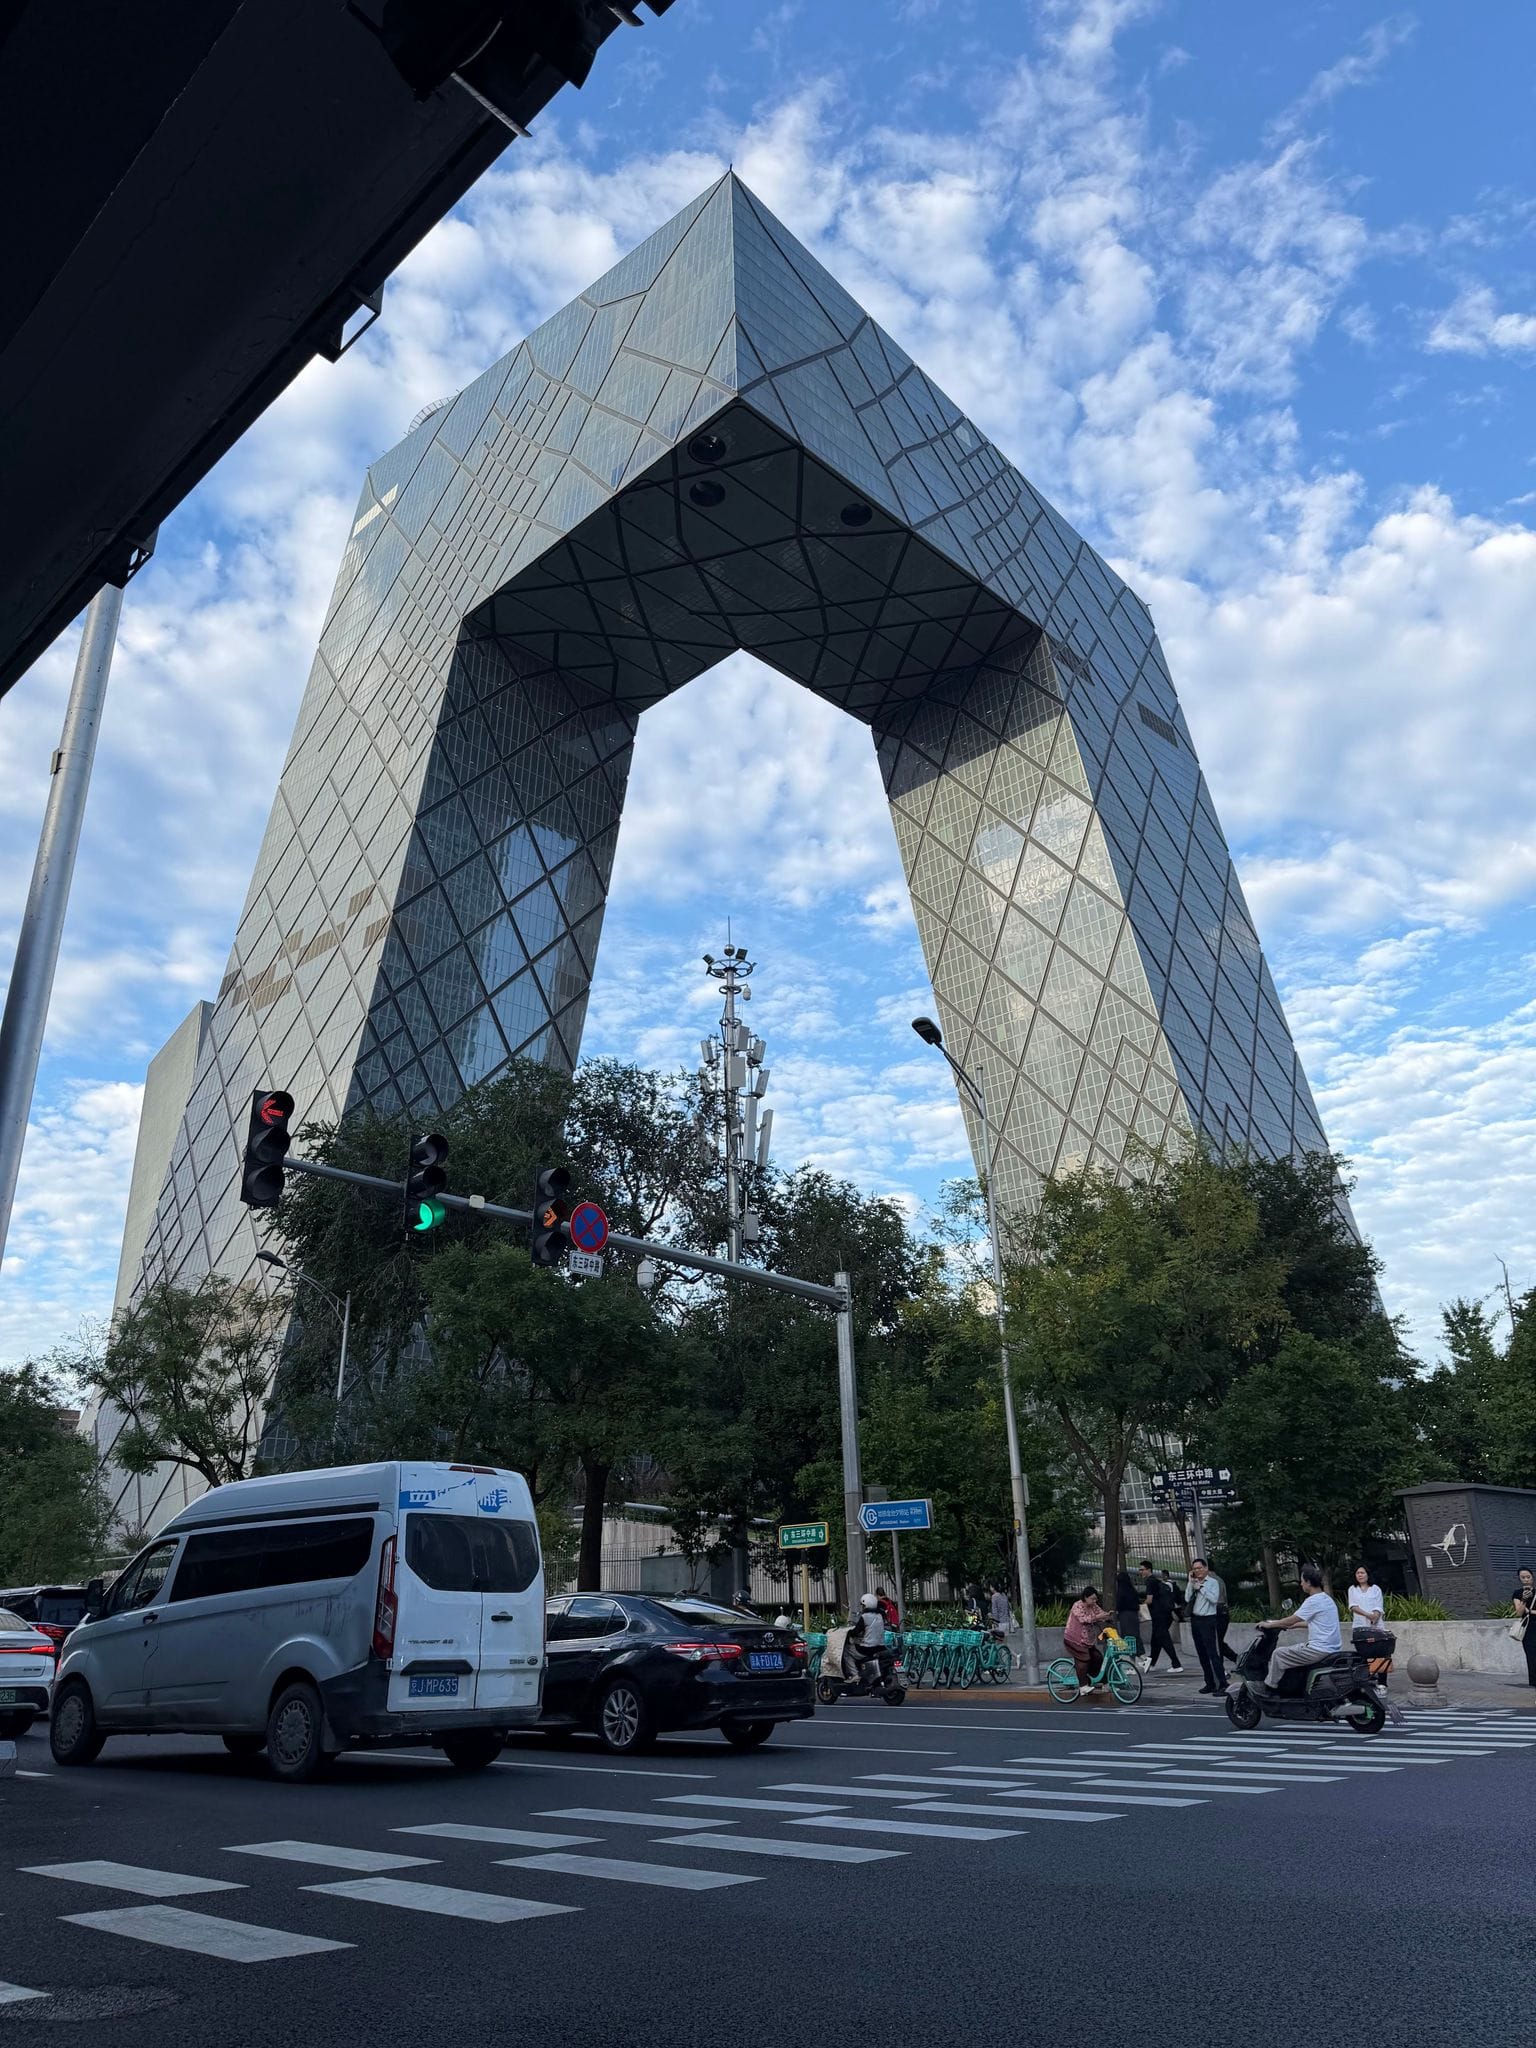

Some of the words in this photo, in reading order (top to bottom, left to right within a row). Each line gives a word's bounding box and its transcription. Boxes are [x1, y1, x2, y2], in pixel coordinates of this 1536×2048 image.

[1168, 1468, 1214, 1481] 东三环中路
[791, 1528, 816, 1539] 东三环中路
